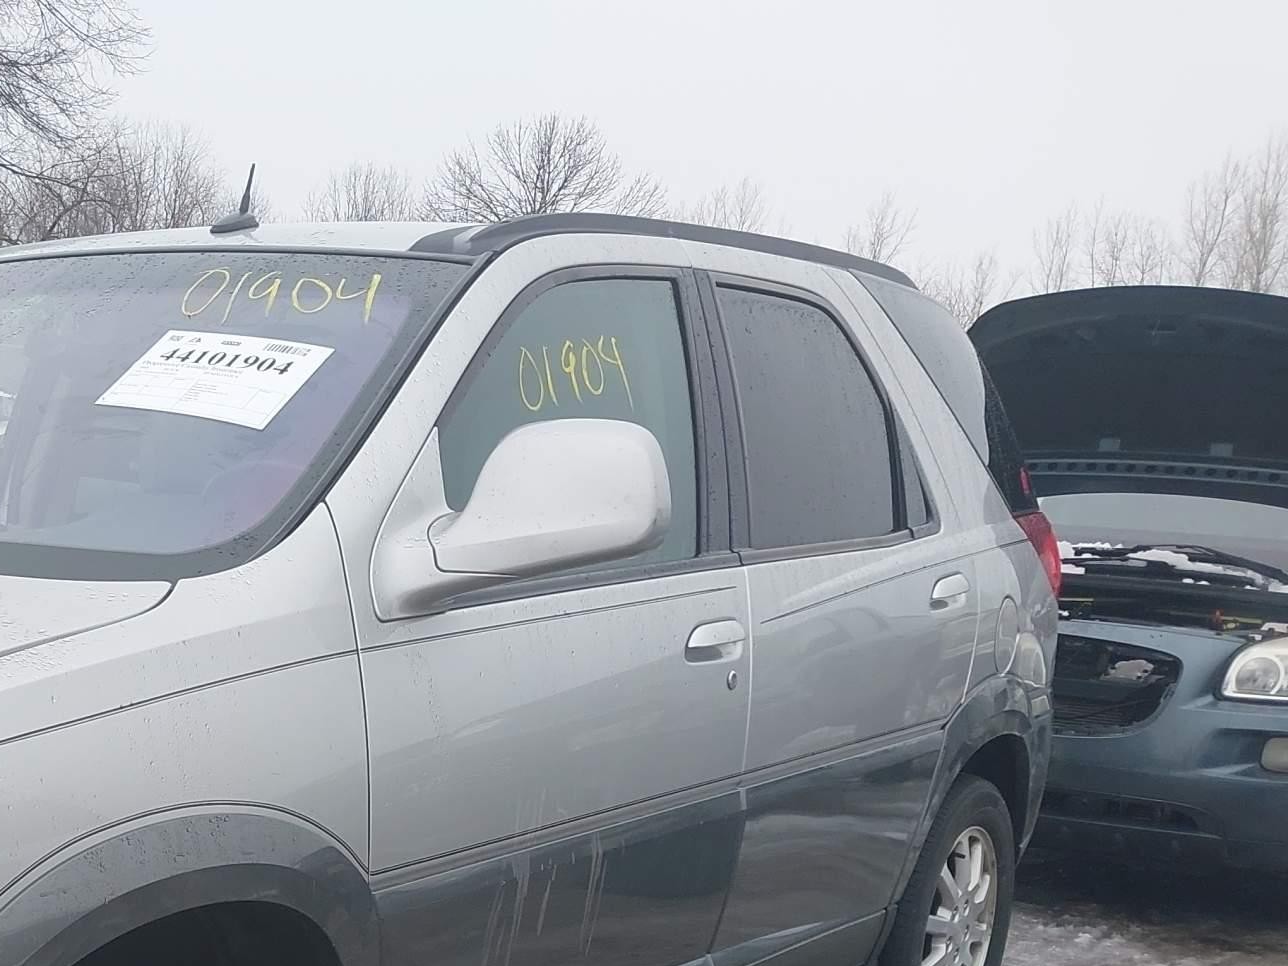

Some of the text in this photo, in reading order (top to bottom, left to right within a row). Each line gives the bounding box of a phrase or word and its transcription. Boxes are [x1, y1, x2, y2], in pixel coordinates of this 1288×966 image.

[181, 266, 382, 325] 01904
[160, 348, 294, 375] 44101904
[519, 335, 634, 411] 01904
